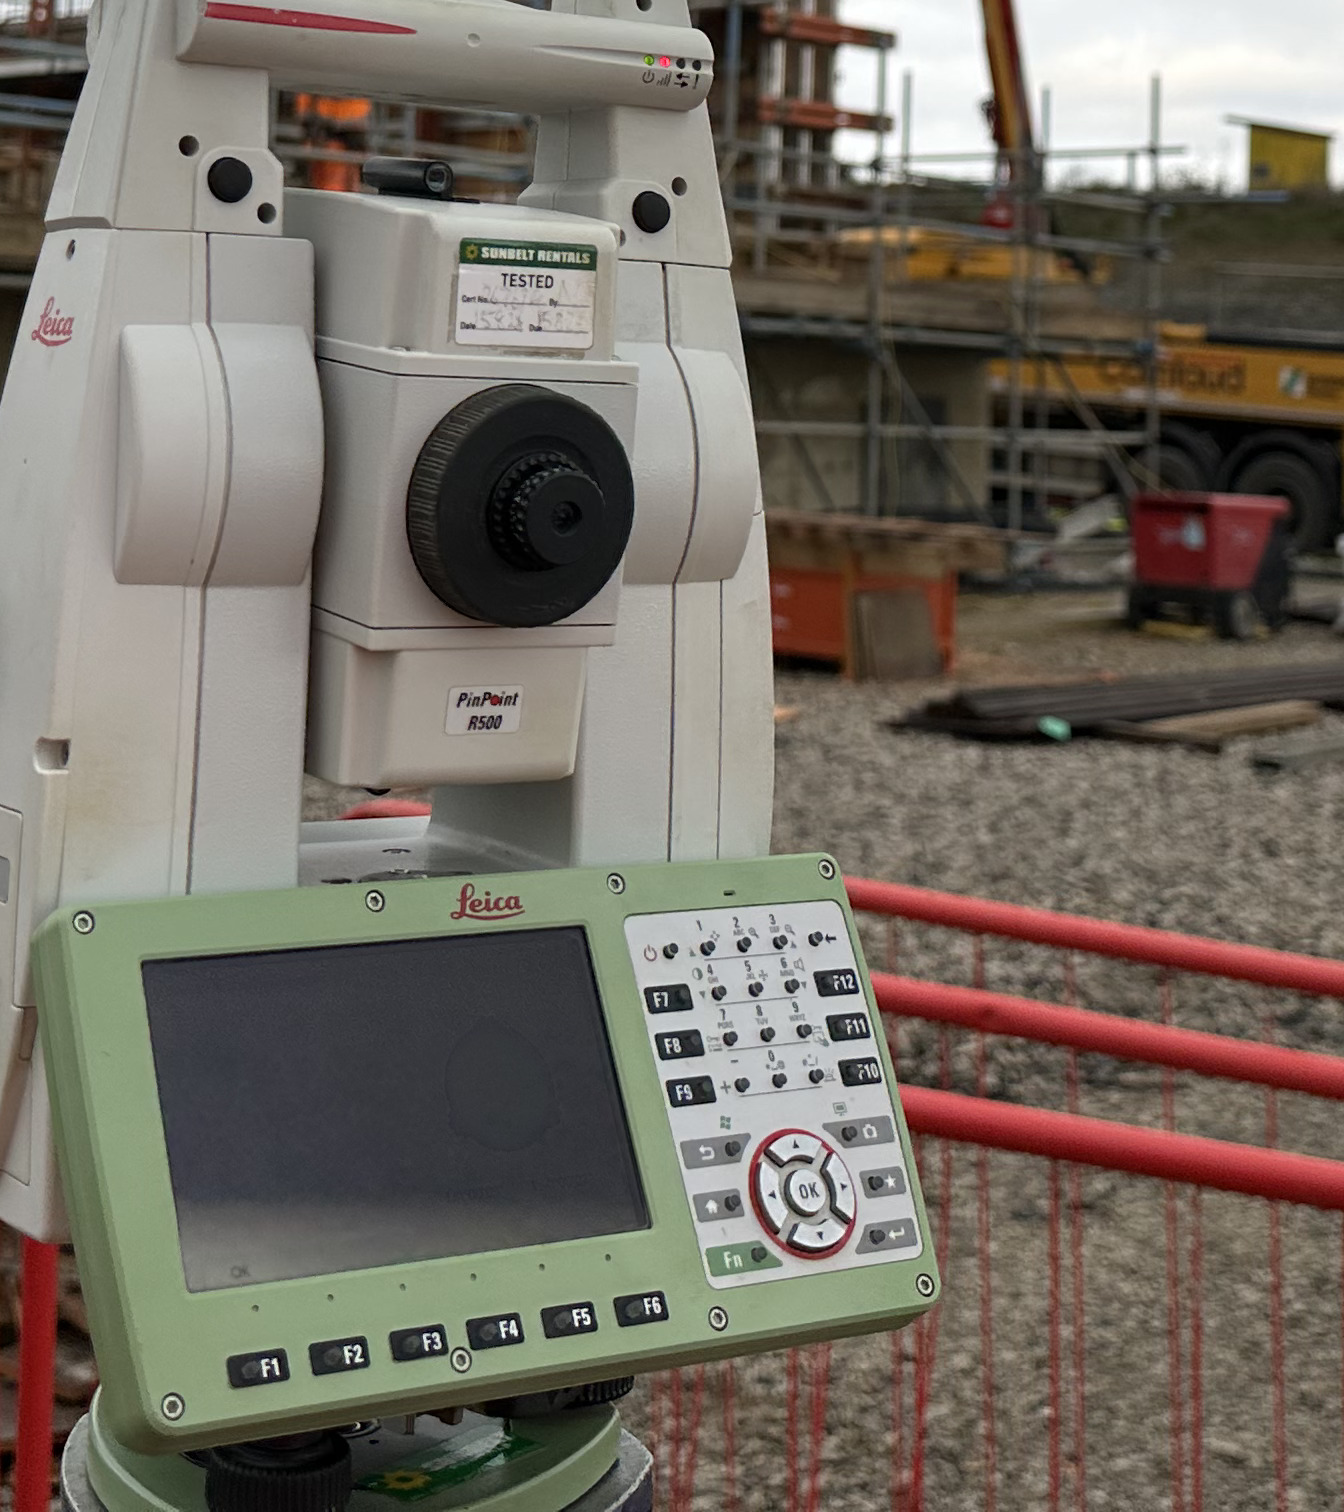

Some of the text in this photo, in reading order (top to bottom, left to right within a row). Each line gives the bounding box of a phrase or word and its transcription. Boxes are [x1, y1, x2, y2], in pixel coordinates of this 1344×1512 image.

[481, 246, 591, 264] SUNBELT RENTALS
[501, 273, 554, 289] TESTED
[31, 296, 75, 347] Leica
[467, 715, 503, 731] R500
[450, 883, 526, 920] Leica
[696, 919, 703, 931] 1
[732, 916, 740, 928] 2
[769, 913, 776, 925] 3
[707, 963, 714, 975] 4
[744, 960, 752, 972] 5
[780, 957, 788, 969] 6
[832, 974, 855, 991] F12
[652, 991, 669, 1008] F7
[792, 1001, 799, 1013] 9
[719, 1008, 726, 1021] 7
[756, 1004, 763, 1017] 8
[845, 1018, 867, 1035] F11
[663, 1037, 682, 1054] F8
[857, 1062, 879, 1080] F10
[675, 1084, 693, 1101] F9
[798, 1182, 820, 1199] OK
[723, 1251, 743, 1270] Fn
[642, 1295, 662, 1316] F6
[571, 1308, 592, 1328] F5
[499, 1319, 520, 1339] F4
[422, 1331, 443, 1352] F3
[343, 1344, 364, 1365] F2
[260, 1356, 281, 1377] F1
